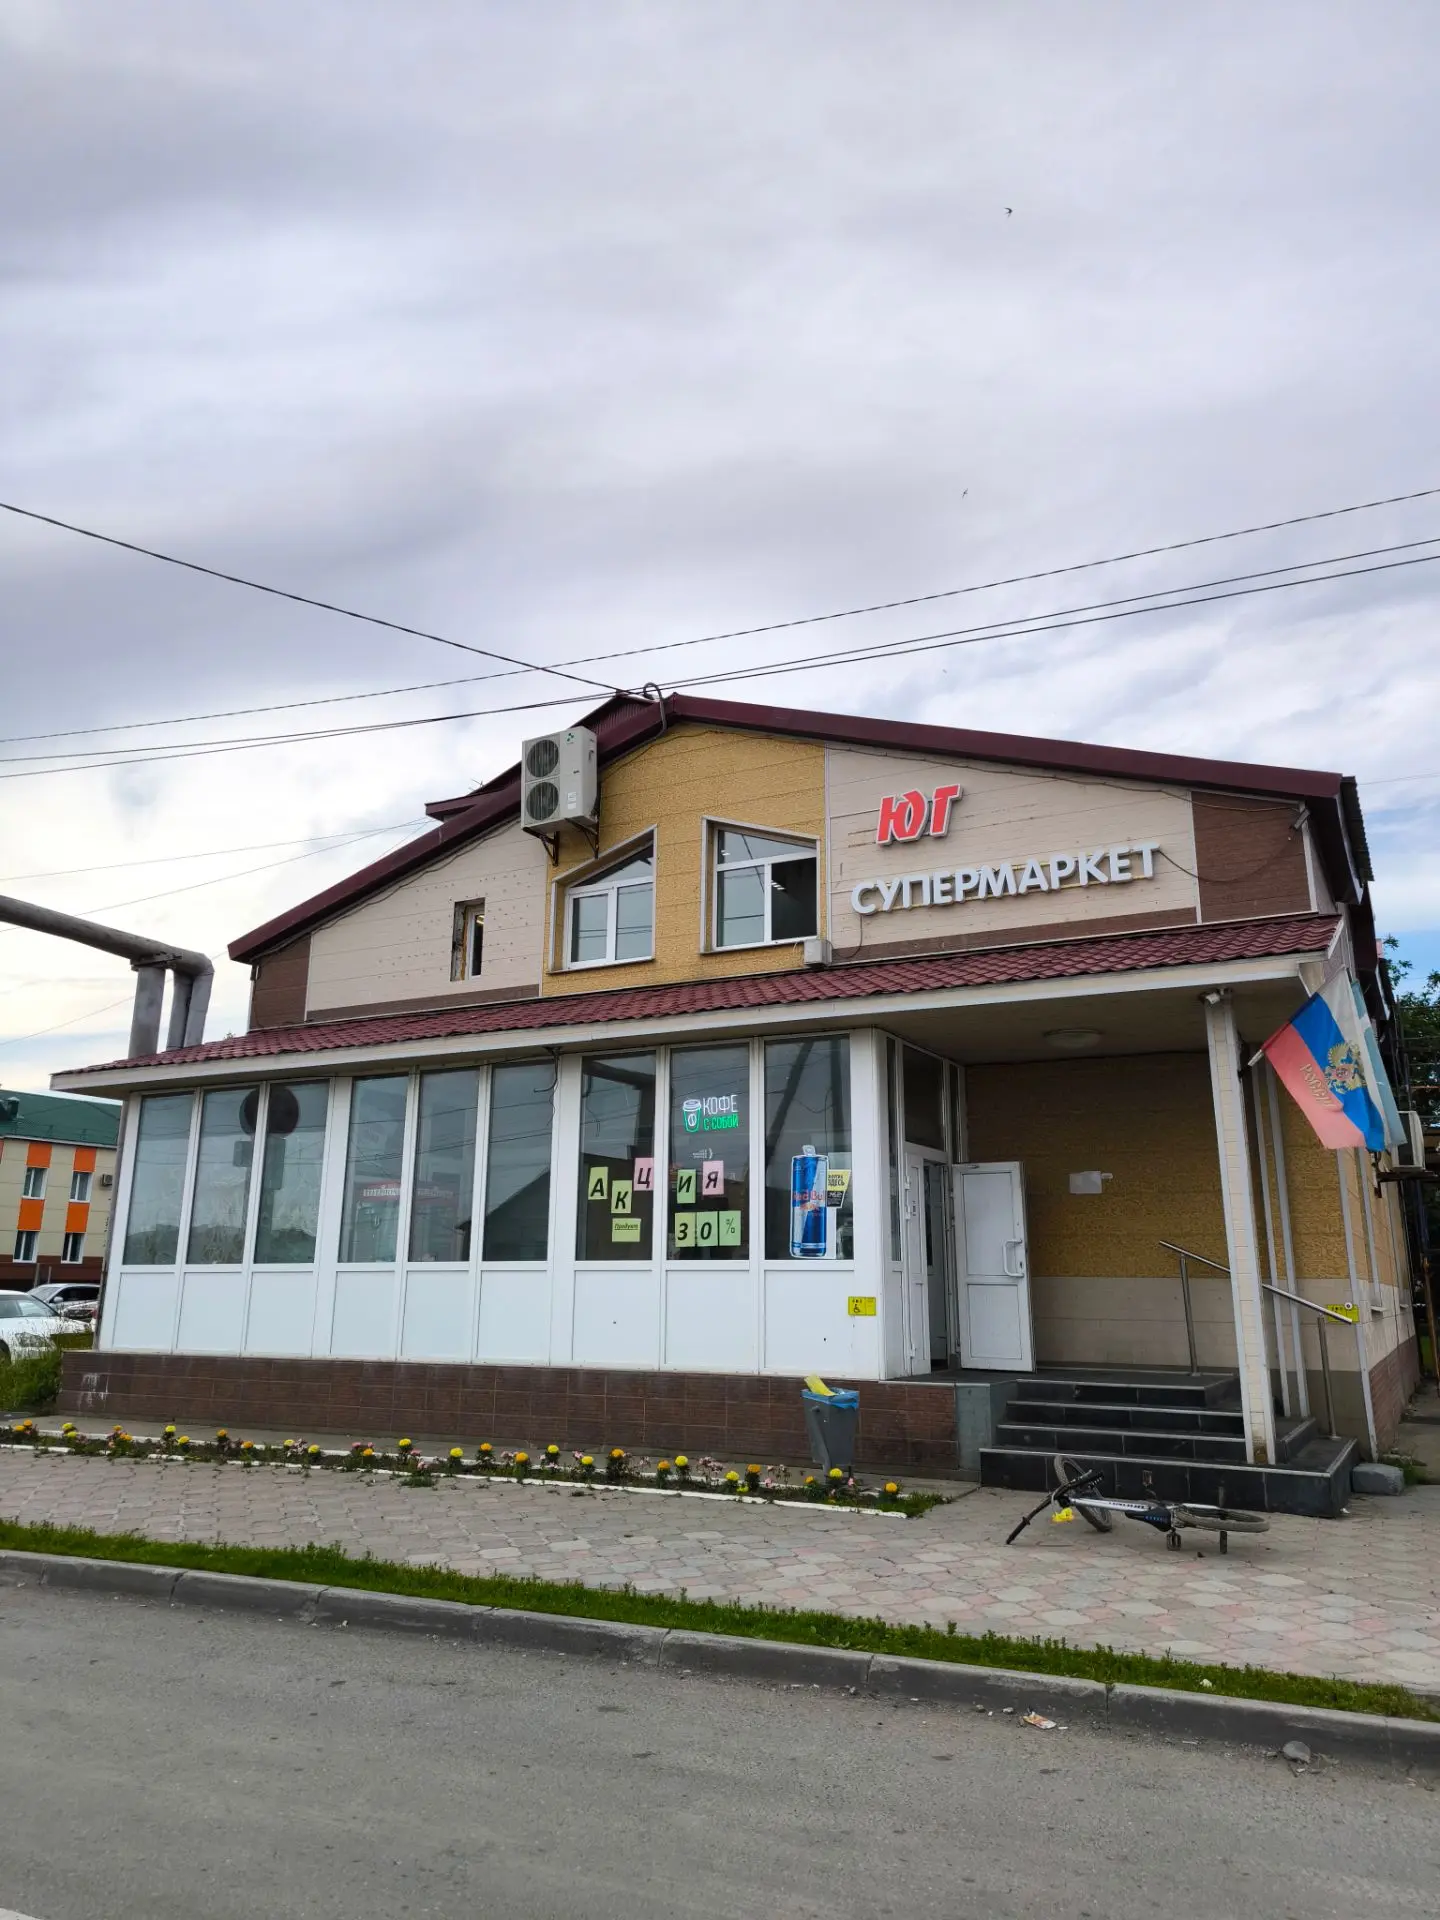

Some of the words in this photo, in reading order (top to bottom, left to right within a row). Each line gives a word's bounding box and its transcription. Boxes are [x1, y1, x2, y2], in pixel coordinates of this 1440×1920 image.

[877, 783, 964, 846] ЮГ
[851, 841, 1161, 915] СУПЕРМАРКЕТ
[702, 1094, 739, 1116] КОФЕ
[711, 1113, 739, 1130] СОБОЙ
[677, 1216, 736, 1241] 30%
